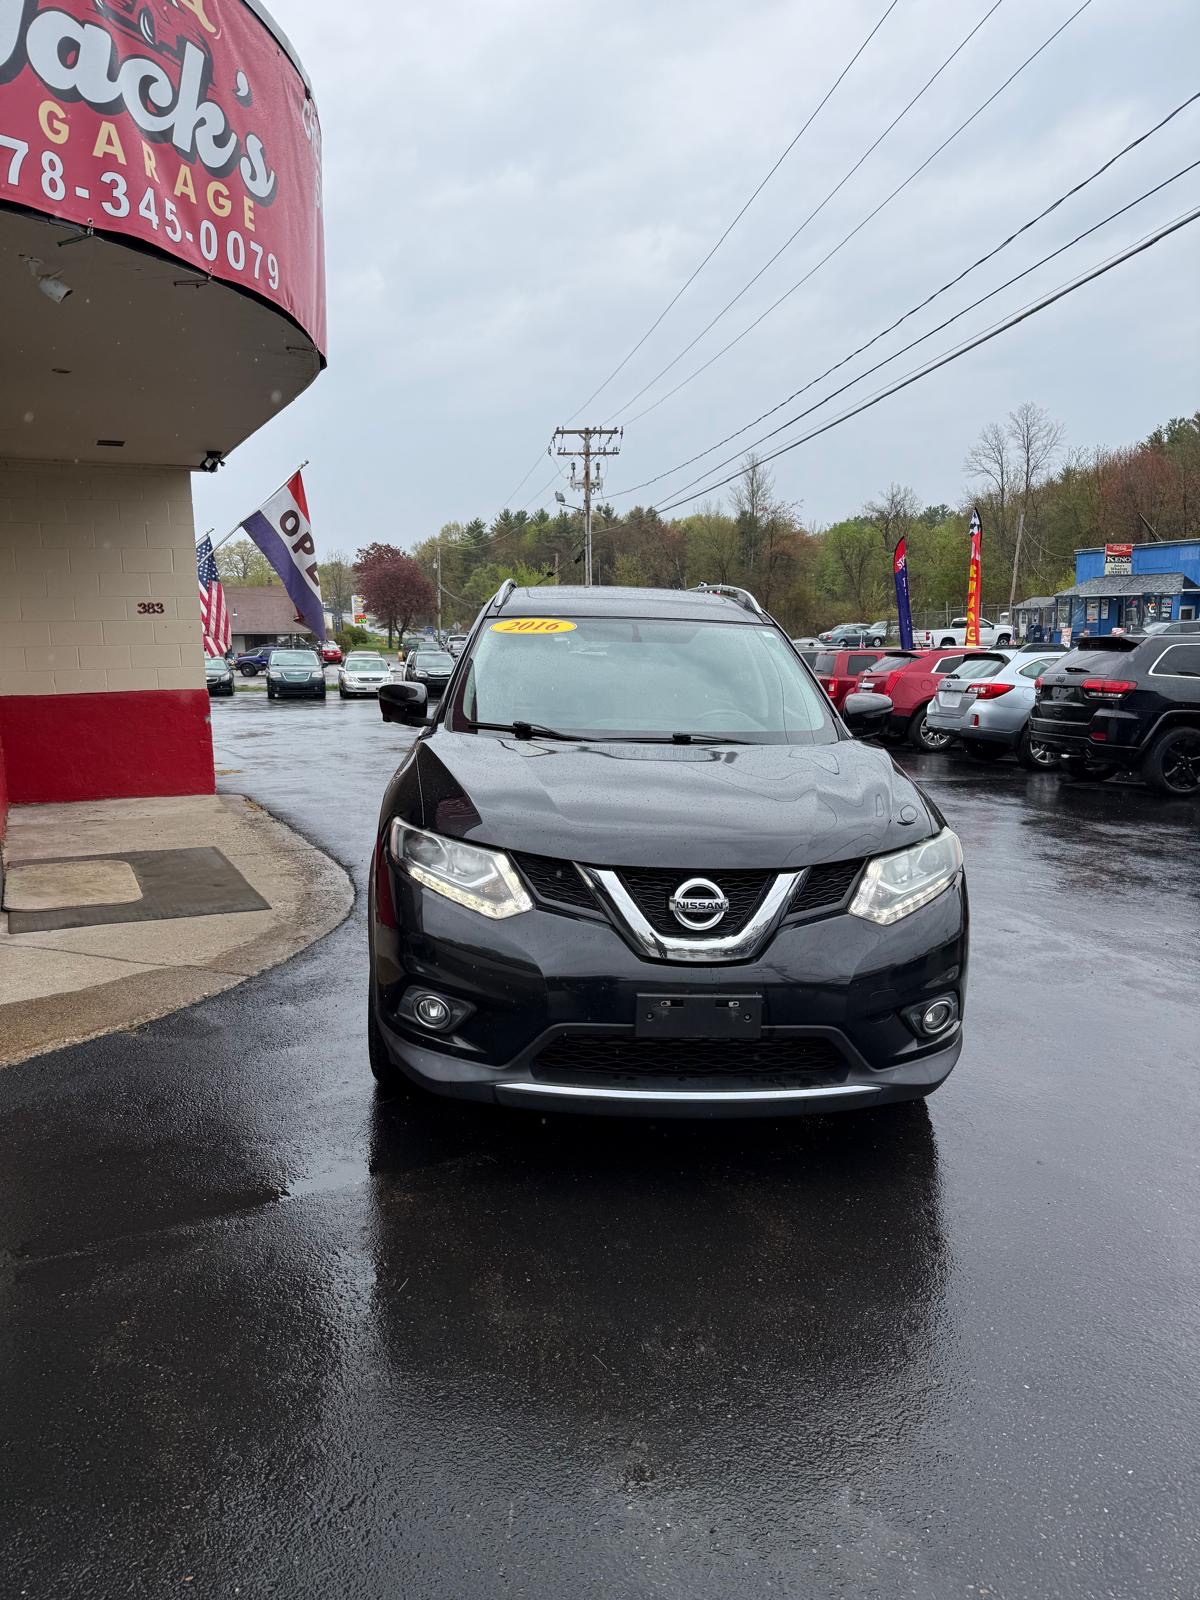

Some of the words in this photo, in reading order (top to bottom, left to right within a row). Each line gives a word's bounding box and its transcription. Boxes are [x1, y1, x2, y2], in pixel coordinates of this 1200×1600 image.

[38, 100, 256, 232] GARAGE
[137, 602, 165, 614] 383
[503, 621, 563, 631] 2016
[676, 901, 724, 910] NISSAN
